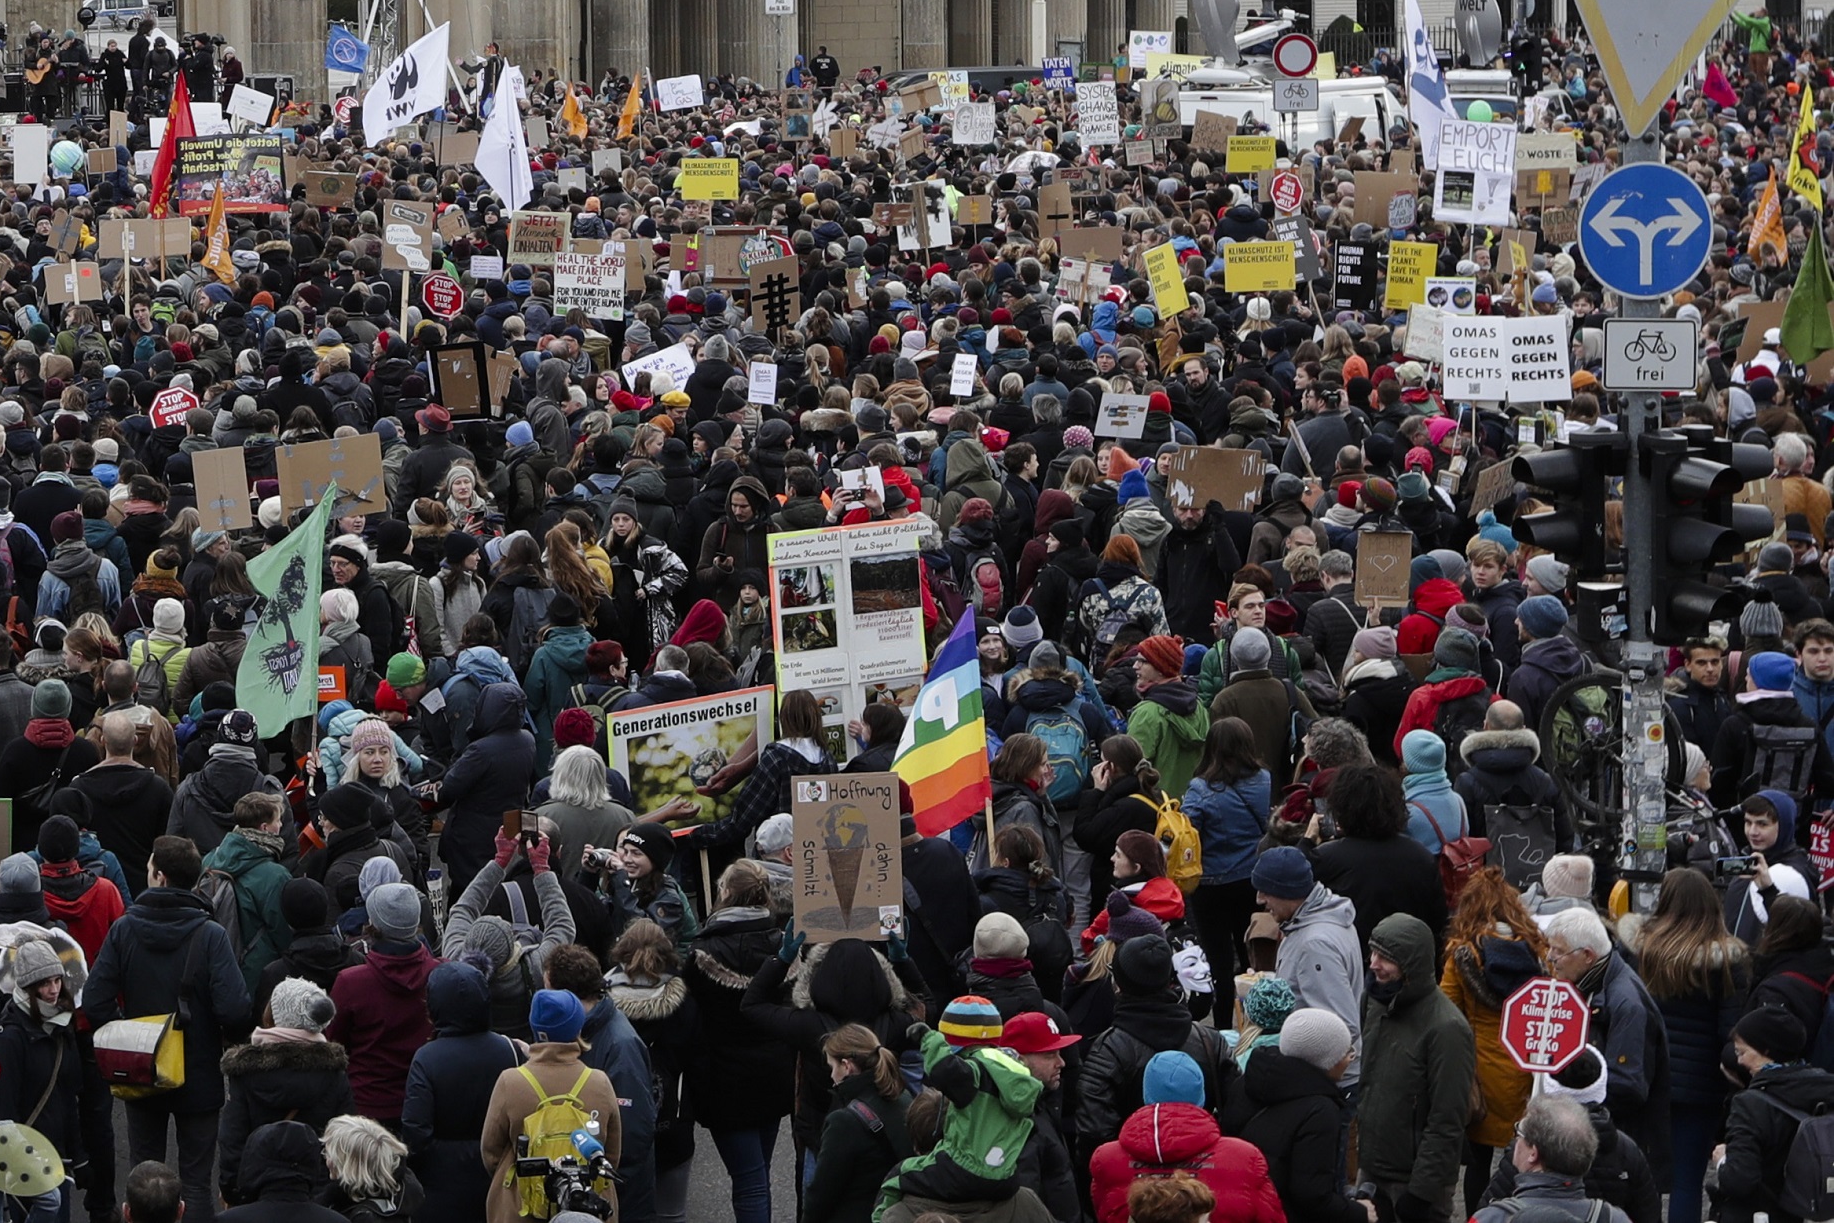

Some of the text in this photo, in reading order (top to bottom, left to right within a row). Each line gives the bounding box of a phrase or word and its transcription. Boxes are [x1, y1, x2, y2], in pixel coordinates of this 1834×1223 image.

[1043, 57, 1071, 69] TATEN
[930, 74, 962, 82] OMAS
[1045, 78, 1074, 88] WORTE
[1078, 85, 1116, 100] SYSTEM
[1078, 100, 1117, 115] CHANGE
[1289, 100, 1304, 108] frei
[1081, 114, 1119, 124] NOT CLIMATE
[1081, 125, 1117, 136] CHANGE!
[1442, 123, 1515, 153] EMPÖRT
[1453, 148, 1508, 177] EUCH
[685, 169, 733, 179] MENSCHENSCHUTZ
[525, 215, 558, 227] JETZT
[513, 240, 554, 253] EINHALTEN
[1229, 245, 1285, 255] KLIMASCHUTZ IST
[1339, 245, 1364, 255] #HUMAN
[1393, 247, 1423, 257] SAVE THE
[557, 253, 578, 265] HEAL
[581, 254, 597, 265] THE
[600, 256, 626, 267] WORLD
[748, 250, 775, 260] KLIMA
[1229, 254, 1289, 265] MENSCHENSCHUTZ
[1339, 255, 1361, 265] RIGHTS
[1391, 257, 1417, 266] PLANET.
[556, 265, 577, 276] MAKE
[592, 266, 618, 277] BETTER
[1339, 265, 1351, 275] FOR
[1391, 267, 1421, 276] SAVE THE
[434, 279, 453, 289] STOP
[577, 277, 602, 286] PLACE
[1338, 276, 1362, 286] FUTURE
[1390, 276, 1415, 285] HUMAN.
[433, 292, 454, 303] STOP
[557, 287, 622, 297] FOR YOU AND FOR ME
[556, 296, 623, 307] AND THE ENTIRE HUMAN
[1453, 327, 1496, 338] OMAS
[1512, 334, 1555, 346] OMAS
[1450, 346, 1499, 358] GEGEN
[1512, 351, 1558, 364] GEGEN
[1447, 367, 1502, 380] RECHTS
[1512, 368, 1565, 381] RECHTS
[1636, 365, 1665, 382] frei
[160, 391, 185, 407] STOP
[817, 533, 839, 543] Welt
[848, 527, 892, 540] haben nicht
[854, 541, 894, 553] das Sagen
[860, 610, 911, 624] Regenwaldbaum
[790, 661, 803, 669] Erde
[859, 658, 907, 670] Quadratkilometer
[820, 666, 845, 675] Millionen
[866, 670, 884, 681] gerade
[903, 666, 921, 676] Jahren
[811, 678, 826, 686] Wald
[612, 697, 758, 737] Generationswechsel
[827, 731, 840, 739] TO
[829, 779, 891, 811] Hoffnung
[802, 839, 821, 897] schmilzt
[1529, 988, 1569, 1006] STOP
[1524, 1020, 1565, 1039] STOP
